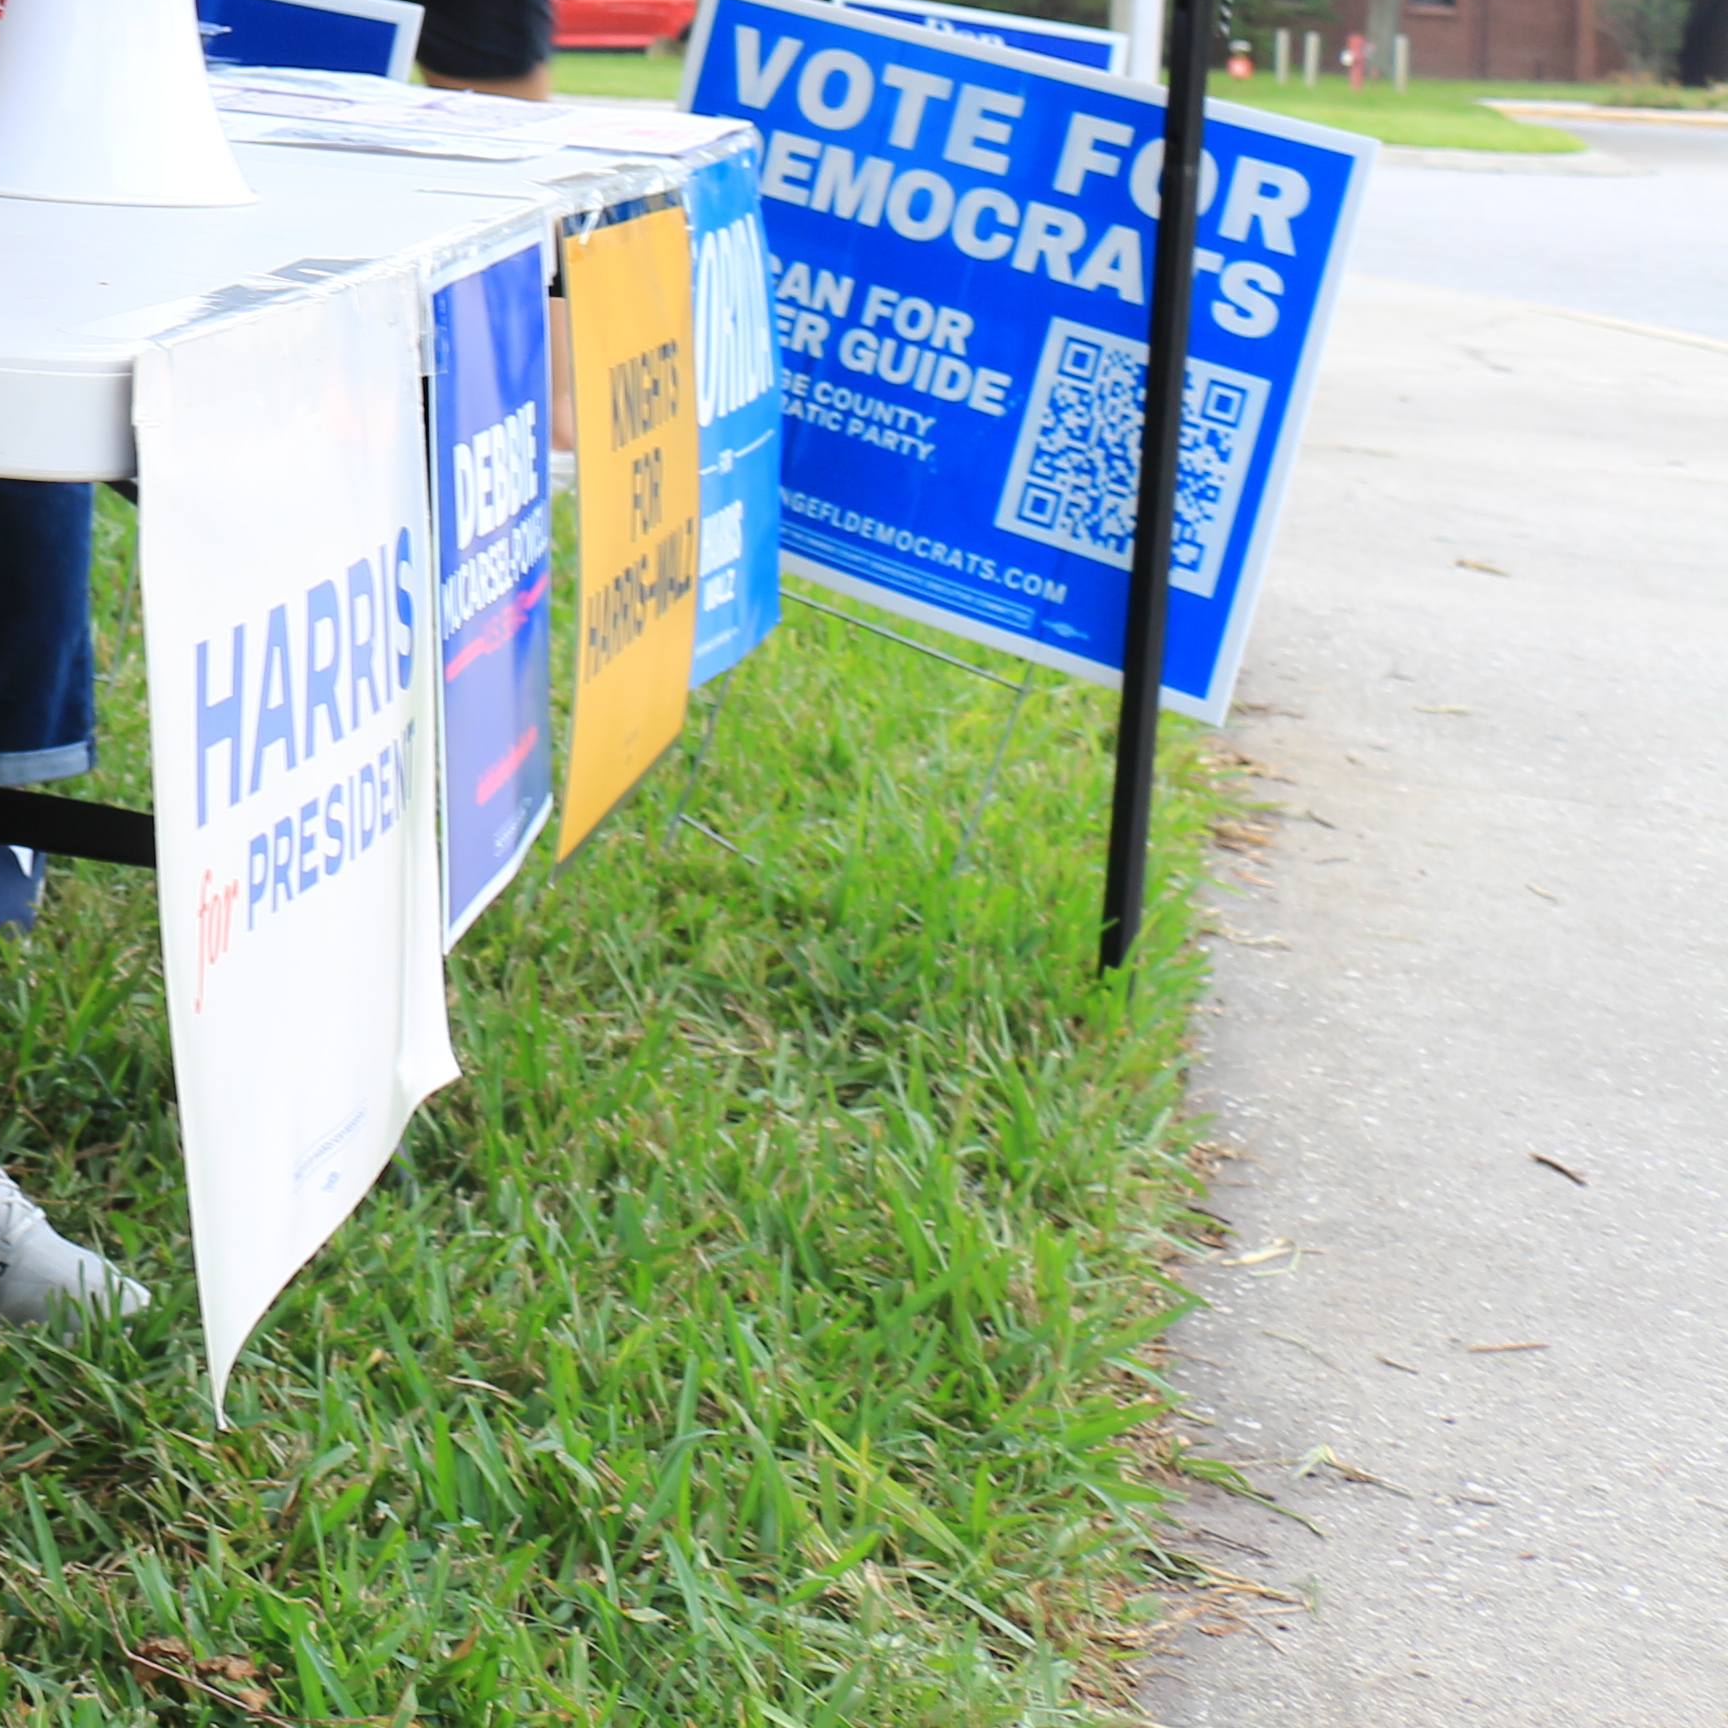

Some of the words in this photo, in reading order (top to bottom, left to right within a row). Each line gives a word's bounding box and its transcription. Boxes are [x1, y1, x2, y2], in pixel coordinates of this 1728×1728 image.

[733, 23, 1026, 176] VOTE
[1053, 110, 1312, 258] FOR
[839, 326, 1012, 419] GUIDE
[862, 286, 975, 357] FOR
[609, 338, 679, 453] KNIGHTS
[813, 381, 937, 437] COUNTY
[846, 417, 936, 462] PARTY
[452, 400, 539, 551] DEBBIE
[630, 447, 662, 542] FOR
[584, 516, 694, 684] HARRIS-WALZ
[195, 525, 414, 830] HARRIS
[196, 868, 238, 1014] for
[247, 717, 416, 933] PRESIDENT
